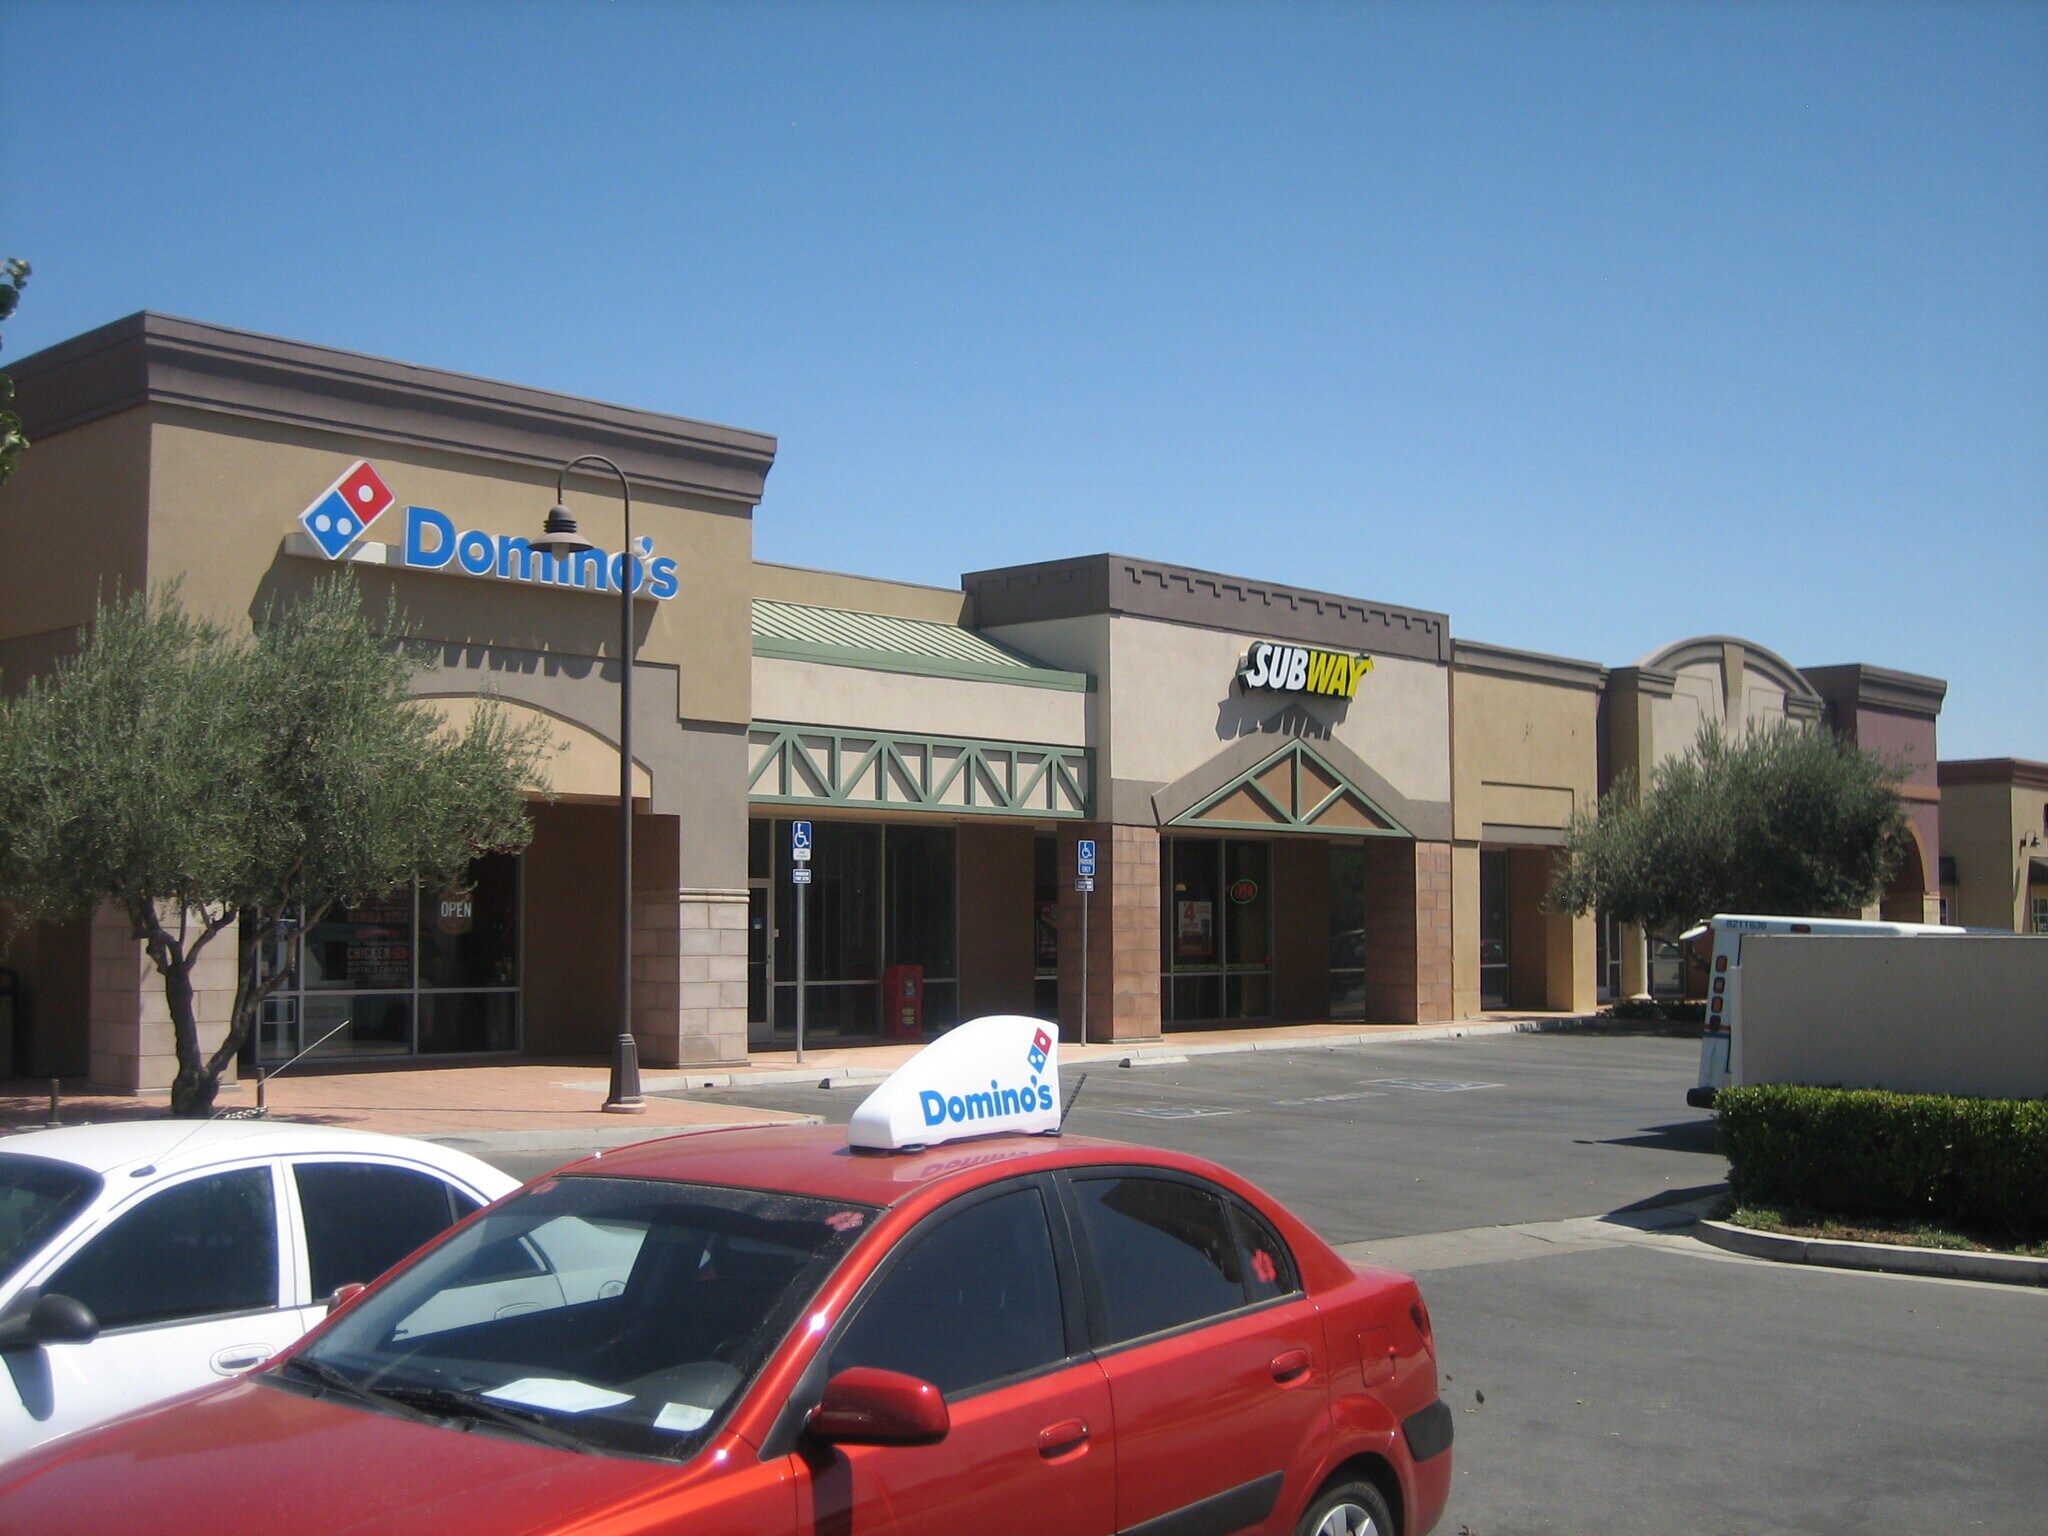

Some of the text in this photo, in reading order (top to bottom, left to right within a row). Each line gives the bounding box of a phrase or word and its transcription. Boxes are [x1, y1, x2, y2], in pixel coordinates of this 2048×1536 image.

[403, 505, 680, 600] Domino's
[1246, 643, 1374, 698] SUBWAY
[441, 901, 473, 918] OPEN
[347, 946, 391, 960] CHICKEN
[919, 1075, 1053, 1126] Domino's
